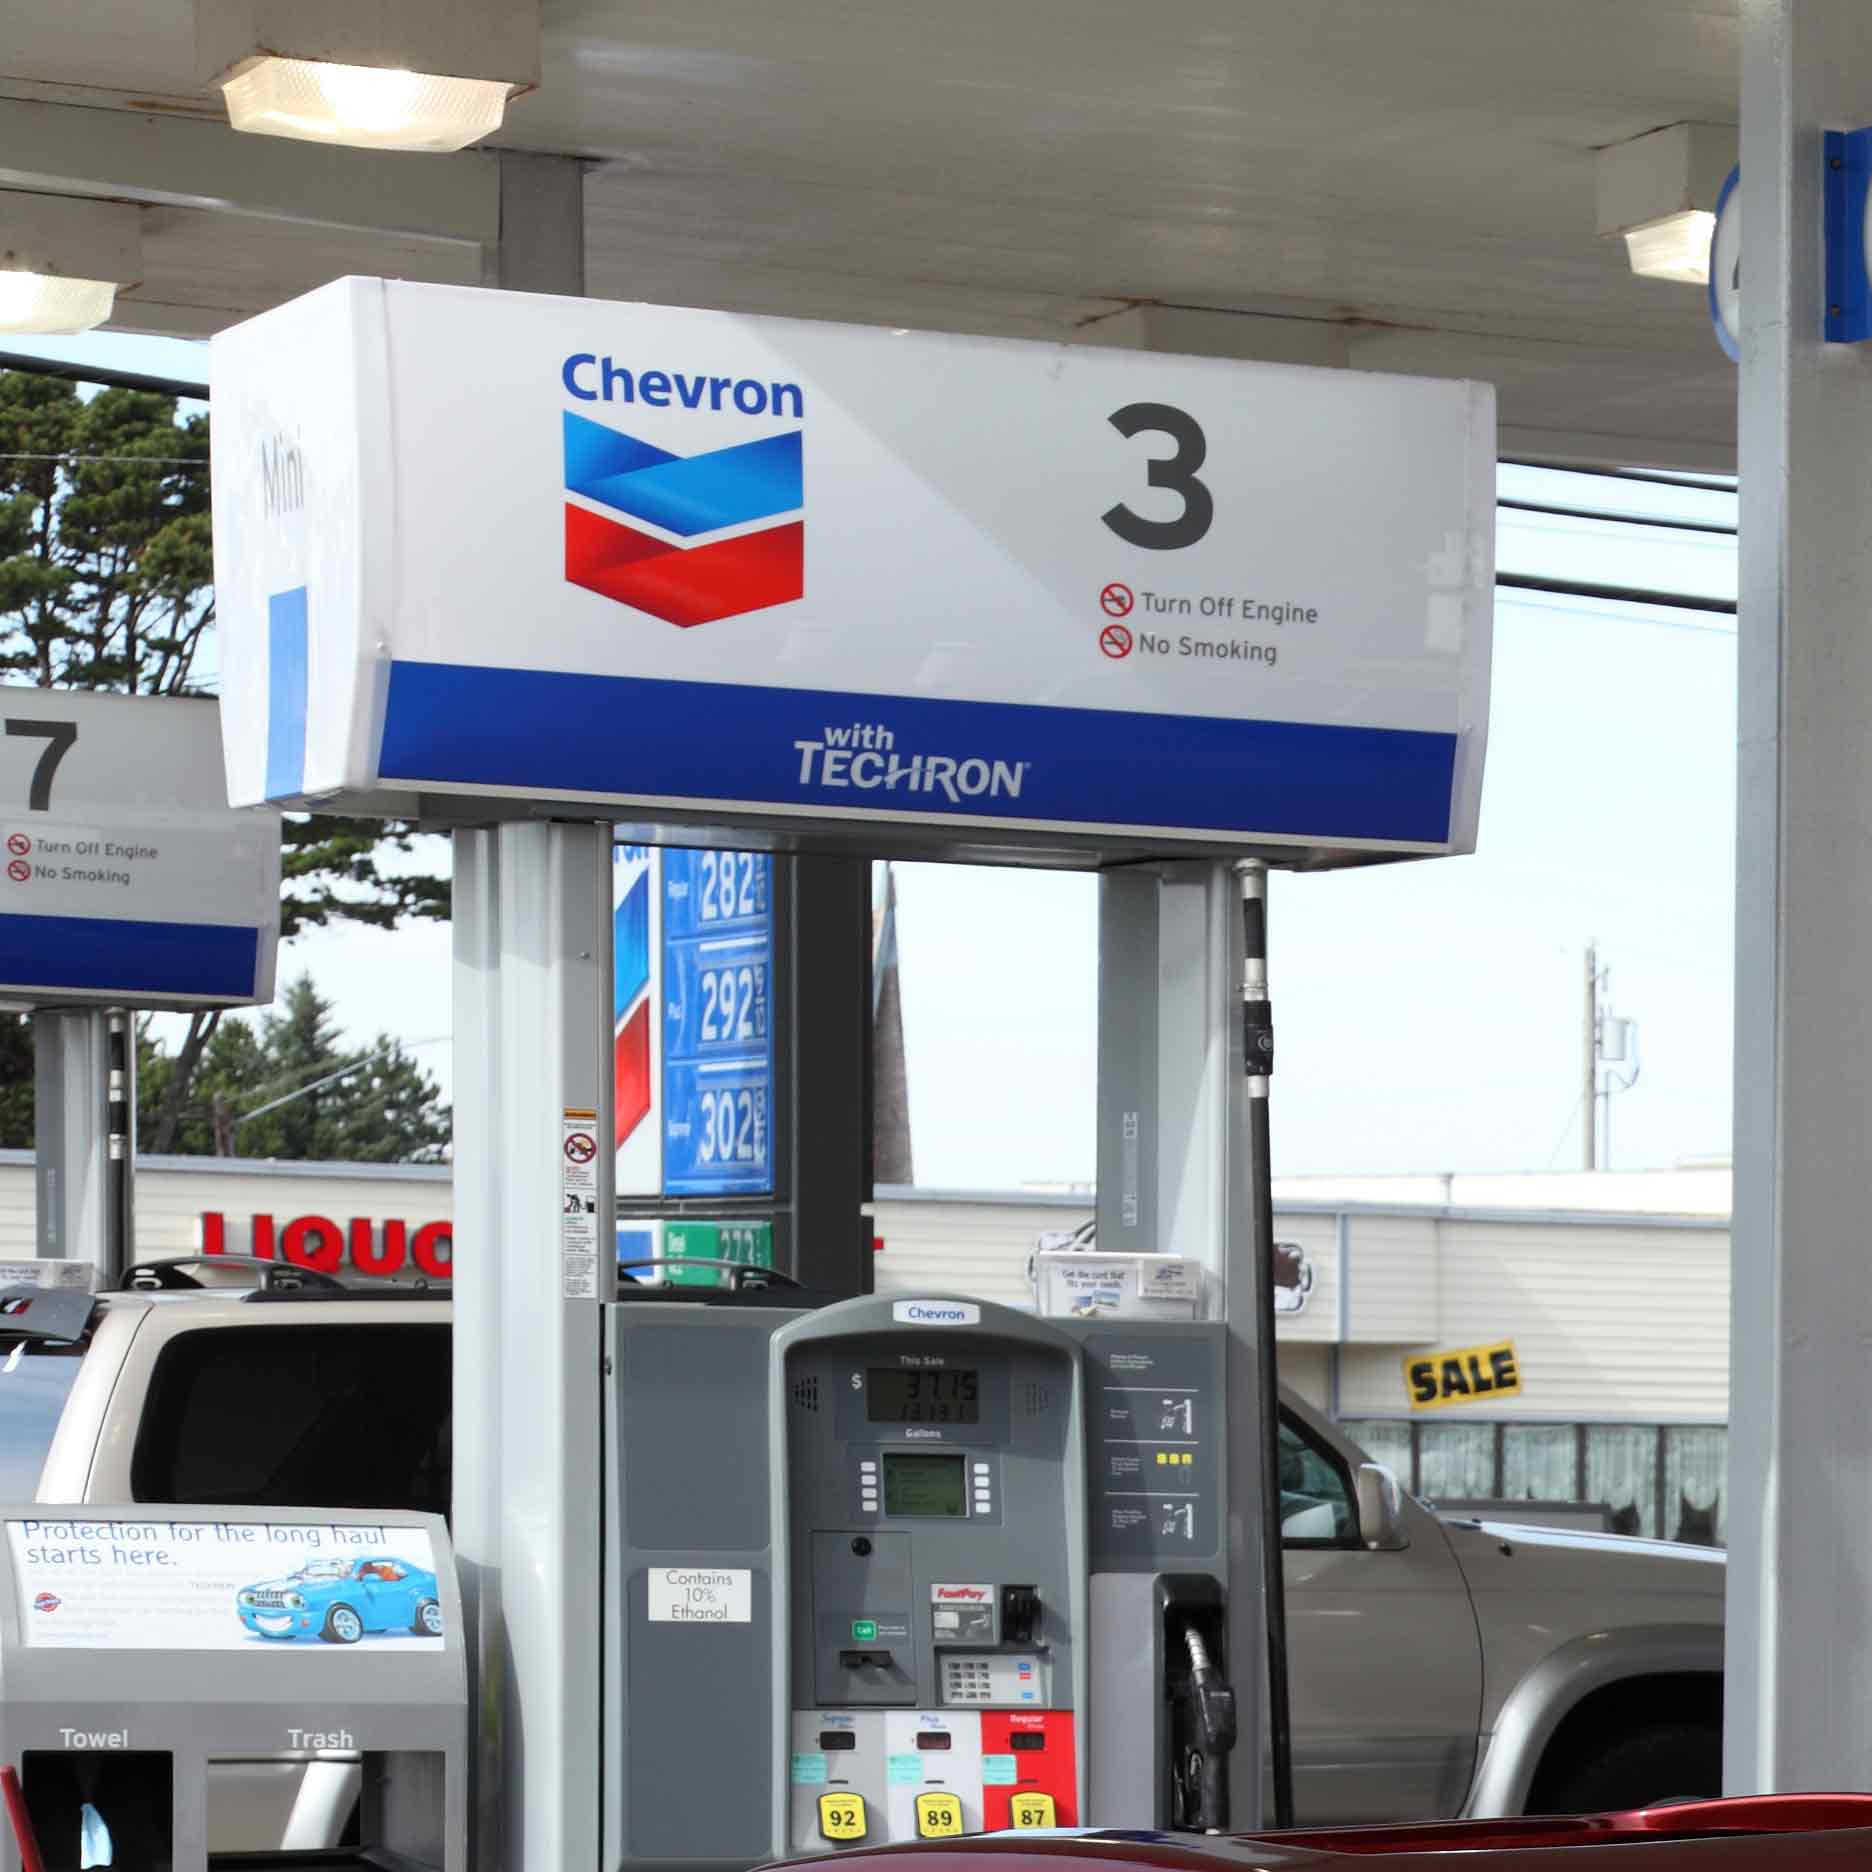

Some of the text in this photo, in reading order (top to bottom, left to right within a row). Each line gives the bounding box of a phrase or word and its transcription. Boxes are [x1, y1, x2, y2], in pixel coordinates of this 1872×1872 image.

[561, 352, 804, 419] Chevron
[260, 431, 304, 520] Mini
[1100, 401, 1214, 551] 3
[1141, 592, 1319, 627] Turn Off Engine
[1138, 634, 1278, 666] No Smoking
[824, 723, 895, 750] with
[4, 717, 78, 812] 7
[793, 740, 1025, 803] TECHRON
[37, 839, 159, 861] Turn Off Engine
[34, 865, 131, 886] No Smoking
[702, 850, 755, 920] 282
[702, 967, 753, 1042] 292
[701, 1090, 753, 1164] 302
[907, 1306, 966, 1321] Chevron
[850, 1373, 863, 1391] $
[1408, 1349, 1518, 1402] SALE
[23, 1520, 388, 1547] Protection for the long haul
[25, 1545, 178, 1567] starts here.
[665, 1569, 733, 1586] Contains
[684, 1586, 718, 1603] 10%
[936, 1587, 986, 1600] FastPay
[671, 1603, 728, 1620] Ethanol
[59, 1727, 130, 1750] Towel
[287, 1728, 354, 1750] Trash
[829, 1809, 856, 1827] 92
[926, 1809, 953, 1827] 89
[1020, 1809, 1045, 1826] 87
